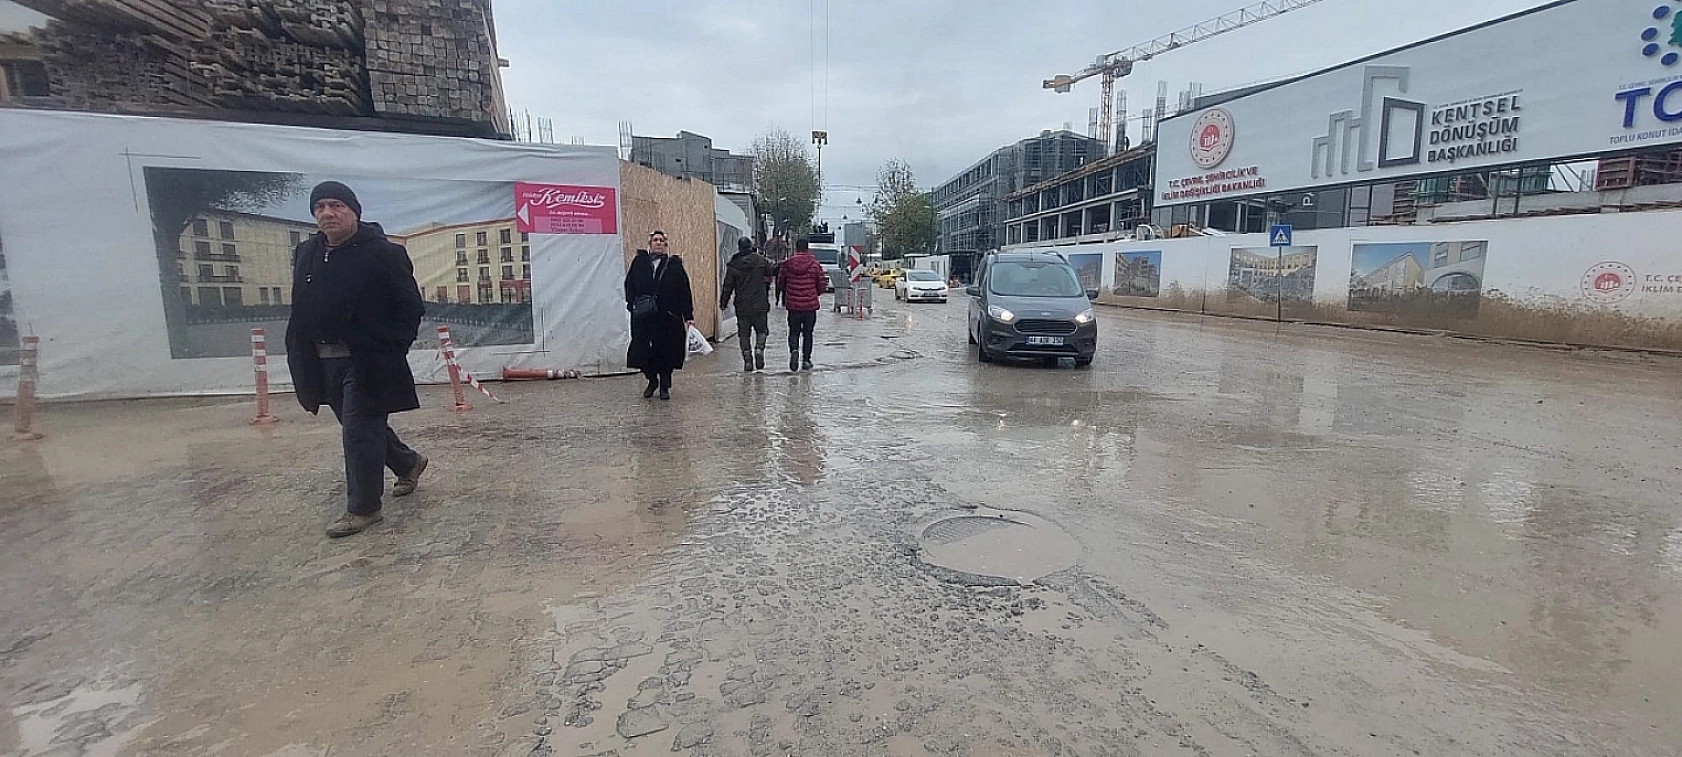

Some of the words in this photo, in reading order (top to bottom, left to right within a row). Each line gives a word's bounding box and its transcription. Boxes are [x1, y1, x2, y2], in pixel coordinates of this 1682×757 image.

[1431, 95, 1520, 125] KENTSEL
[1429, 116, 1520, 145] DÖNÜŞÜM
[1610, 133, 1635, 144] TOPLU
[1637, 129, 1667, 141] KONUT
[1427, 135, 1518, 163] BAŞKANLIĞI
[1221, 177, 1266, 192] BAKANLIĞI
[531, 187, 606, 209] Kemiksiz
[1645, 274, 1664, 282] T.C.
